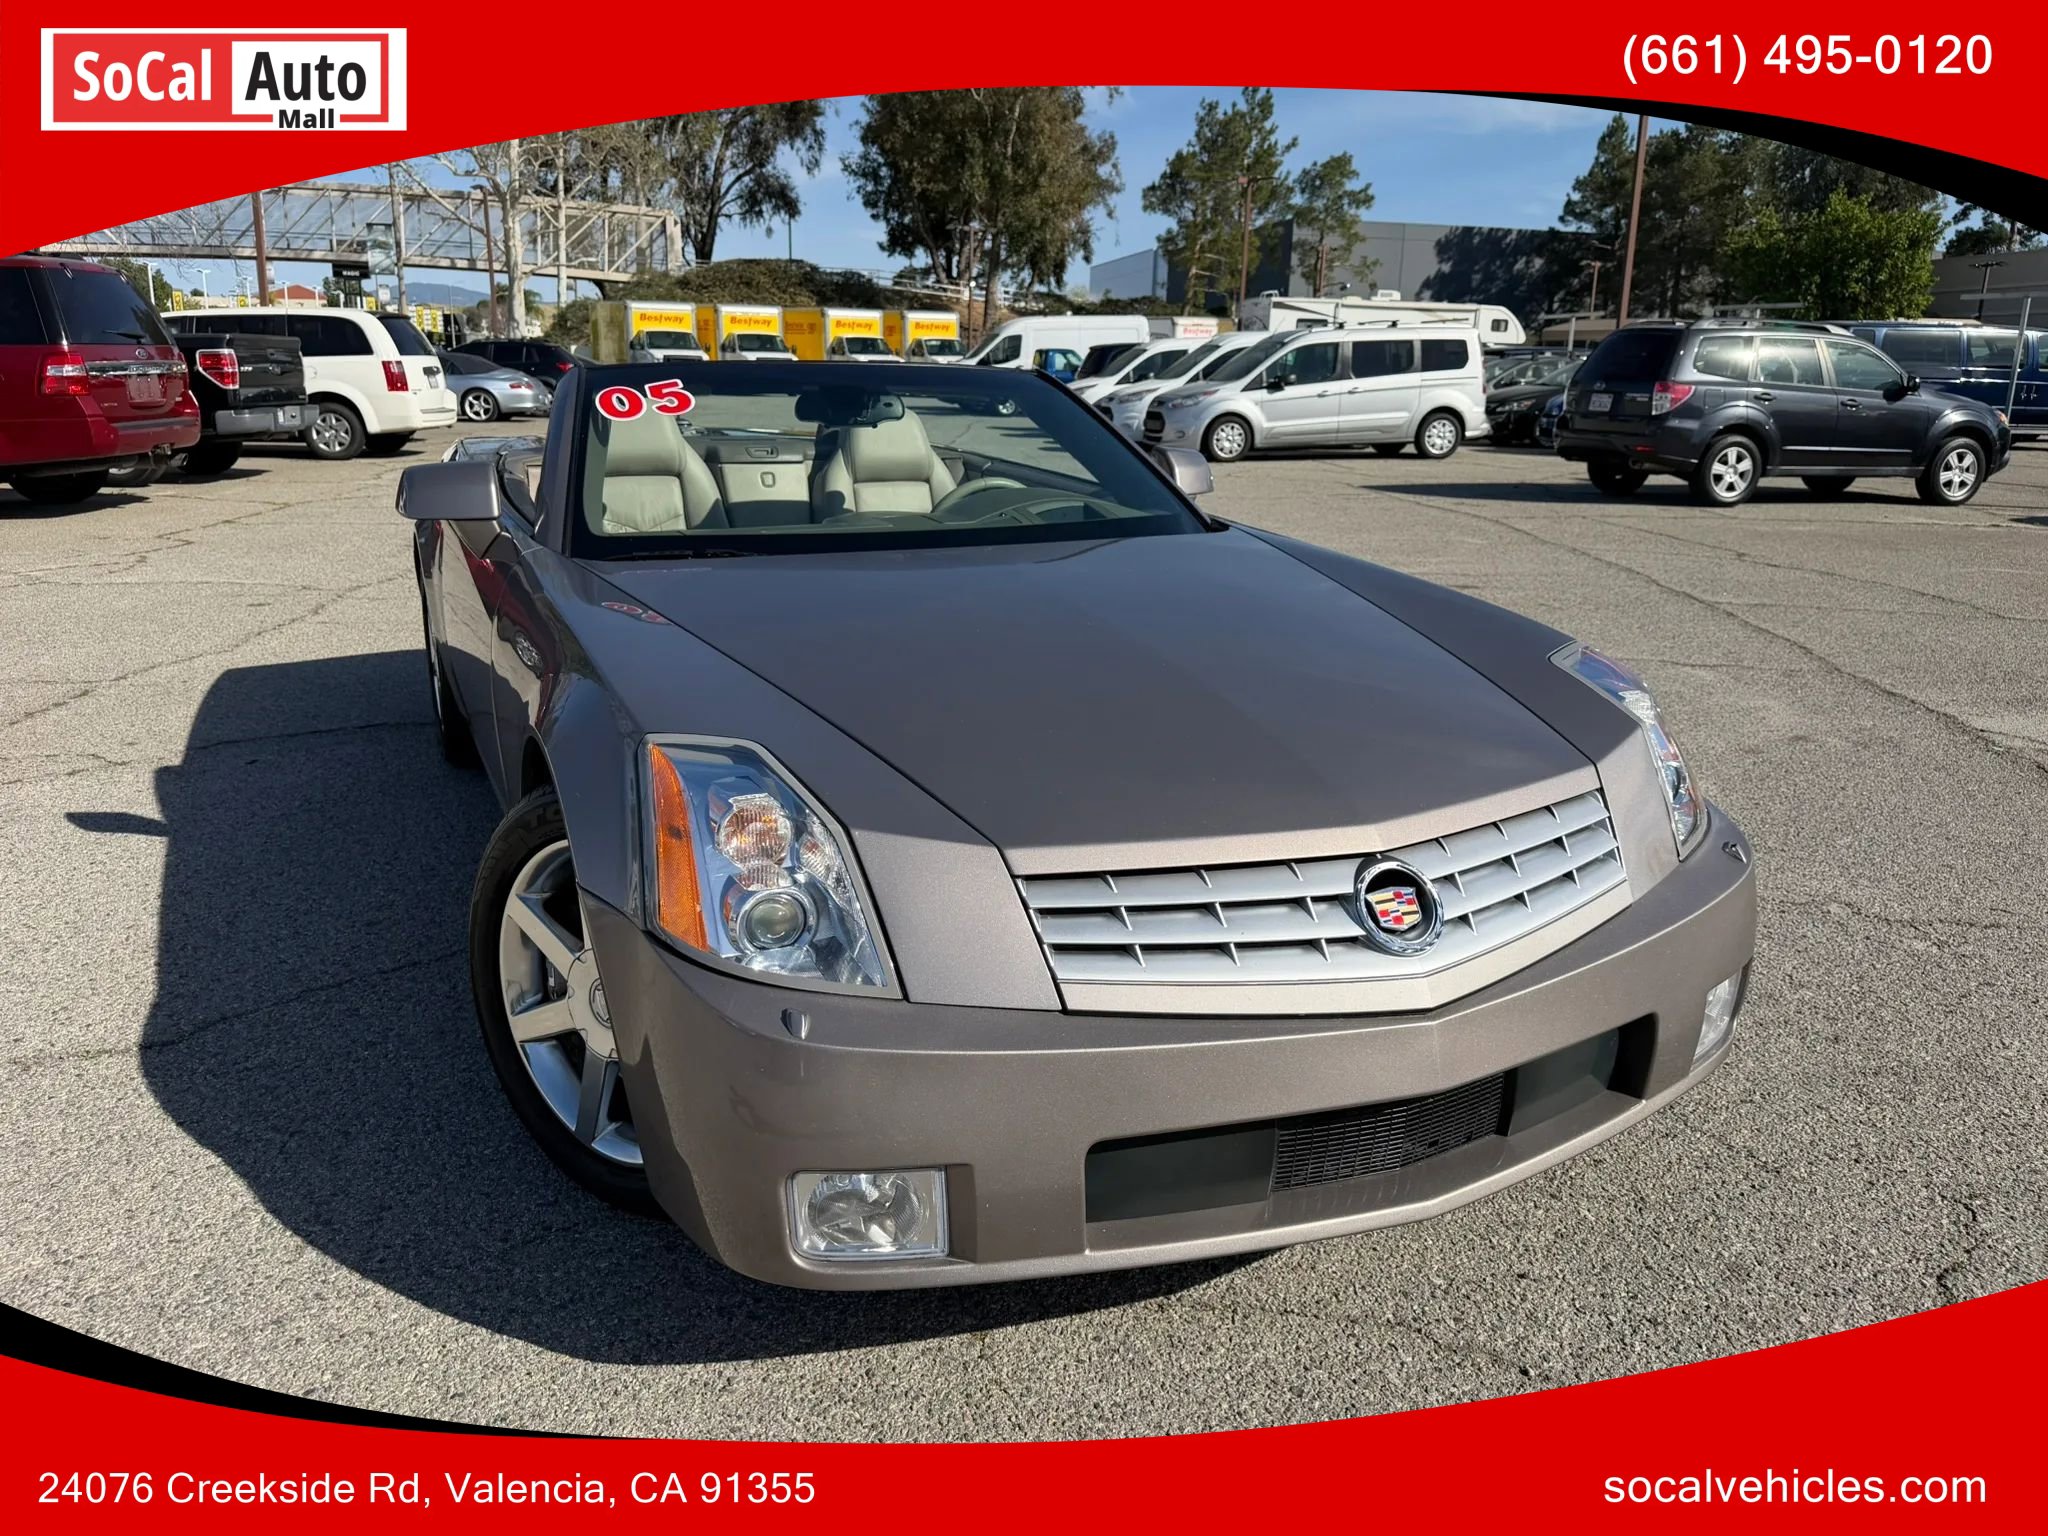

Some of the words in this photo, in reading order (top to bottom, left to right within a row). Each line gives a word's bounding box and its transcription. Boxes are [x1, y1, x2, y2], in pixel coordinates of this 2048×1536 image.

[639, 312, 685, 325] Bestway
[730, 316, 772, 328] Bestway
[835, 320, 873, 331] Bestway
[914, 322, 950, 332] Bestway
[595, 379, 696, 421] 05
